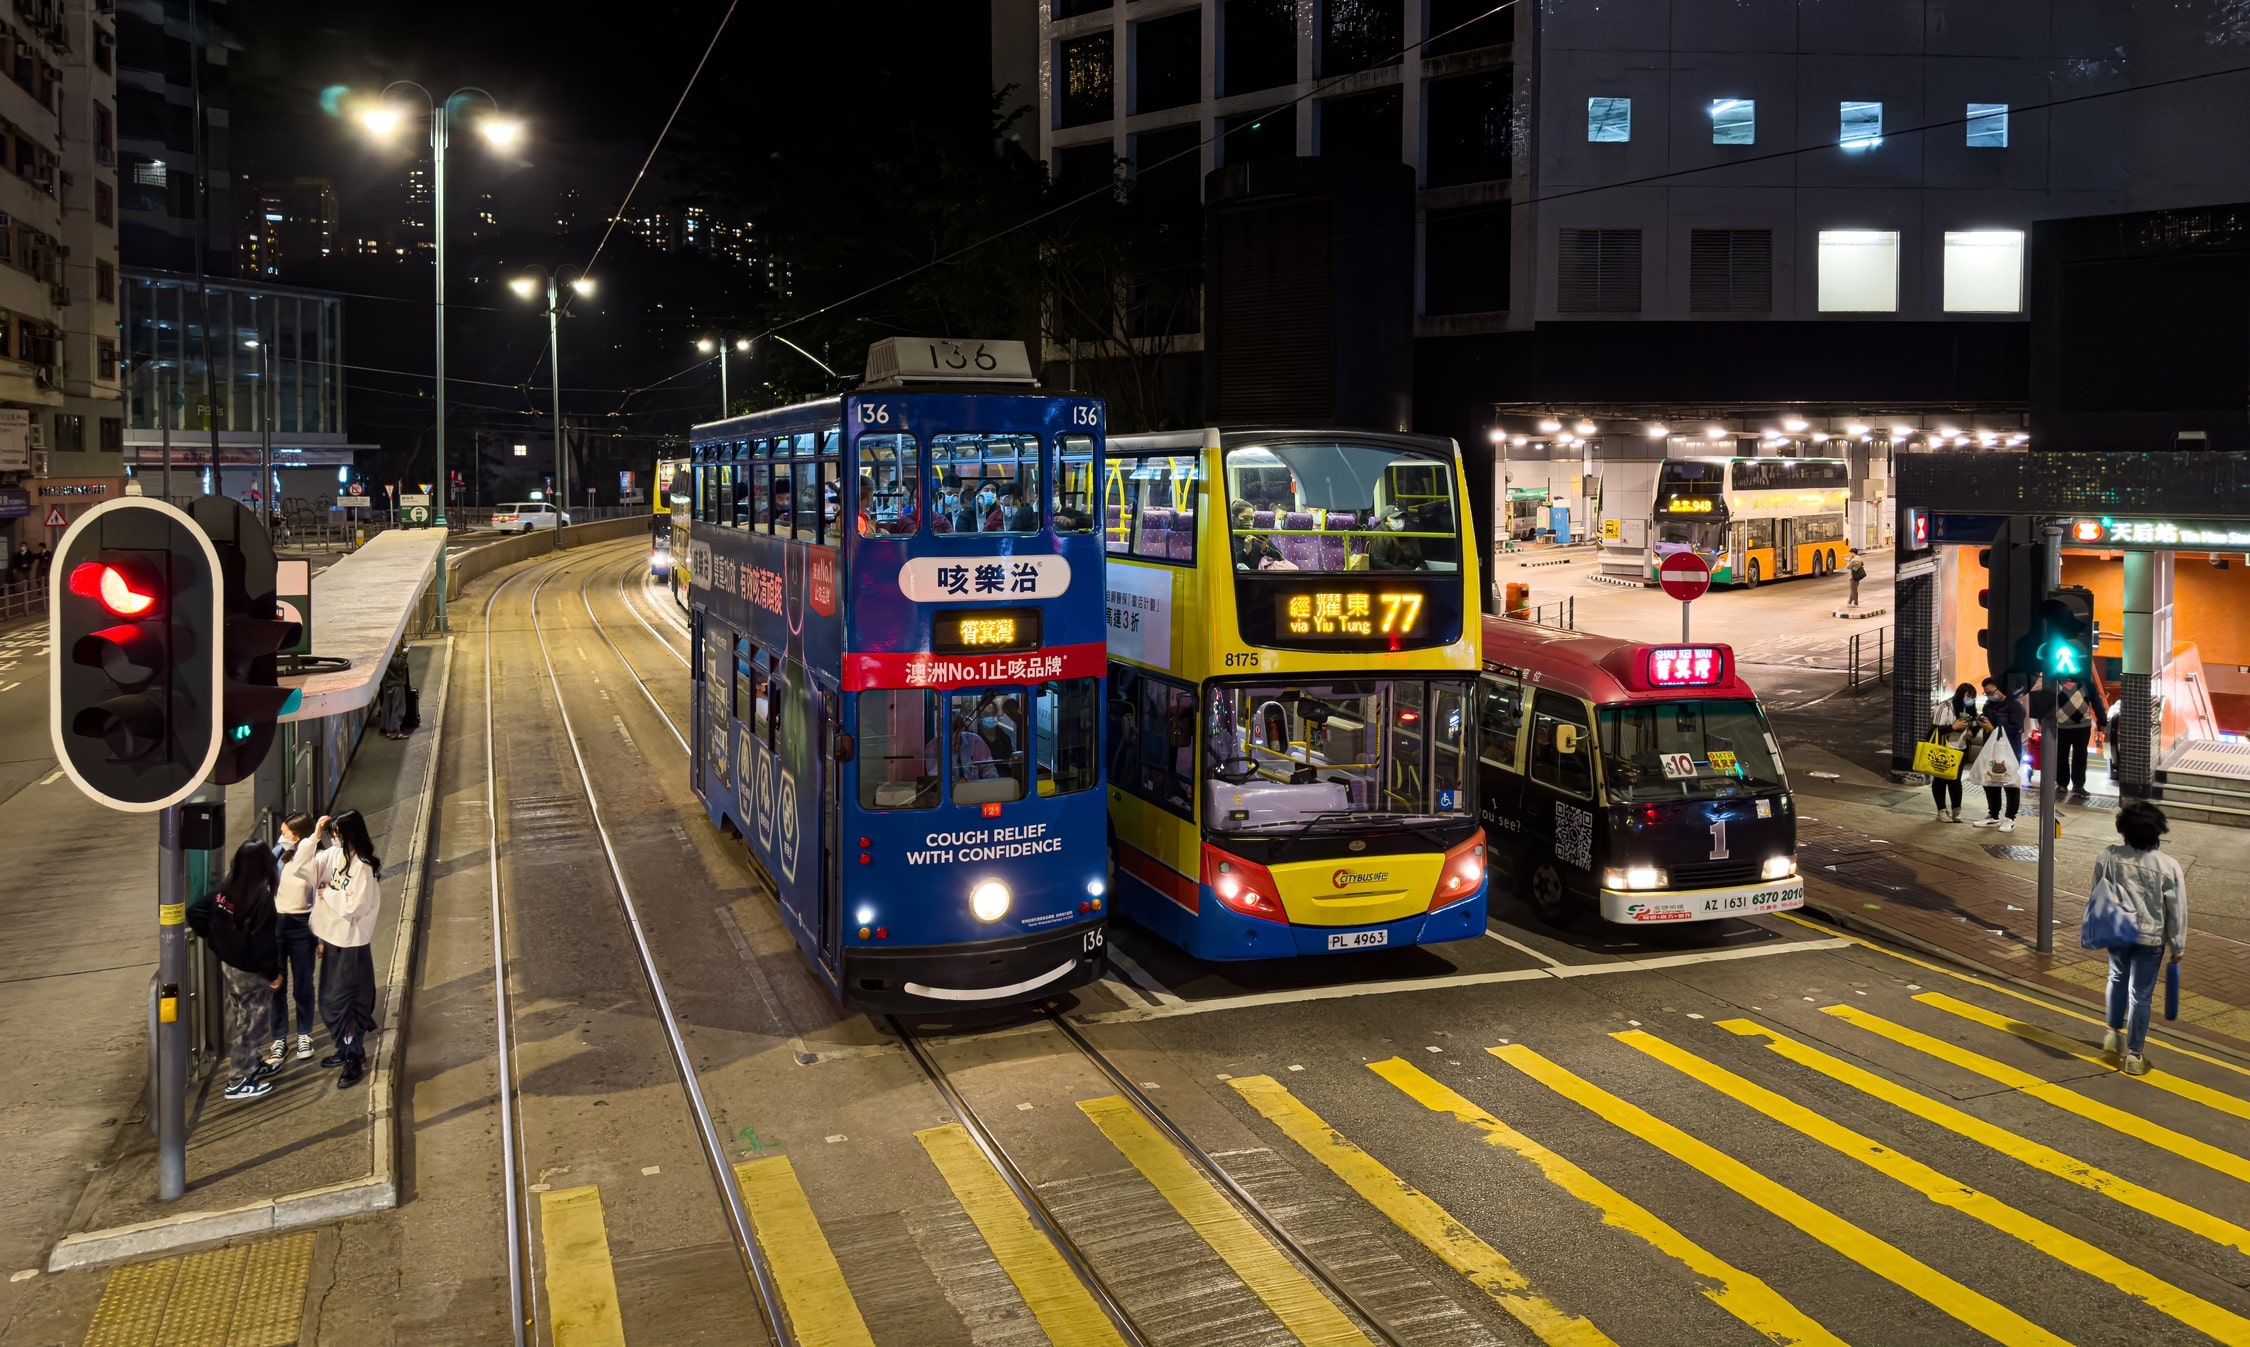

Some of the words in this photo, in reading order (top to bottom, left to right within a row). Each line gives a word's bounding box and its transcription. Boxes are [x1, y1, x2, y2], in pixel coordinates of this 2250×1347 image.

[930, 341, 997, 371] 136
[857, 403, 889, 424] 136
[1073, 406, 1097, 426] 136
[1692, 500, 1712, 512] 948
[2111, 523, 2178, 543] 天后站
[937, 562, 1039, 594] 咳樂治
[1290, 593, 1370, 618] 經耀東
[1380, 593, 1424, 633] 77
[1106, 606, 1140, 633] 高達3折
[1290, 620, 1308, 633] via
[1314, 616, 1334, 633] Yiu
[1338, 616, 1371, 635] Tung
[960, 618, 1014, 645] 筲箕灣
[1225, 653, 1258, 667] 8175
[1655, 649, 1676, 660] SHAU
[1679, 649, 1692, 659] KEI
[1694, 649, 1713, 659] WAN
[905, 655, 1063, 684] 澳洲No.1止咳品牌
[1664, 754, 1694, 776] $10
[982, 806, 1000, 816] 121
[1498, 815, 1521, 833] see?
[926, 829, 989, 847] COUGH
[993, 823, 1047, 843] RELIEF
[1709, 819, 1730, 860] 1
[906, 850, 954, 865] WITH
[958, 837, 1062, 863] CONFIDENCE
[1704, 900, 1718, 911] AZ
[1724, 897, 1747, 909] 1631
[1752, 891, 1779, 905] 6370
[1781, 887, 1803, 902] 2010
[1083, 927, 1104, 953] 136
[1332, 936, 1348, 948] PL
[1354, 932, 1385, 946] 4963
